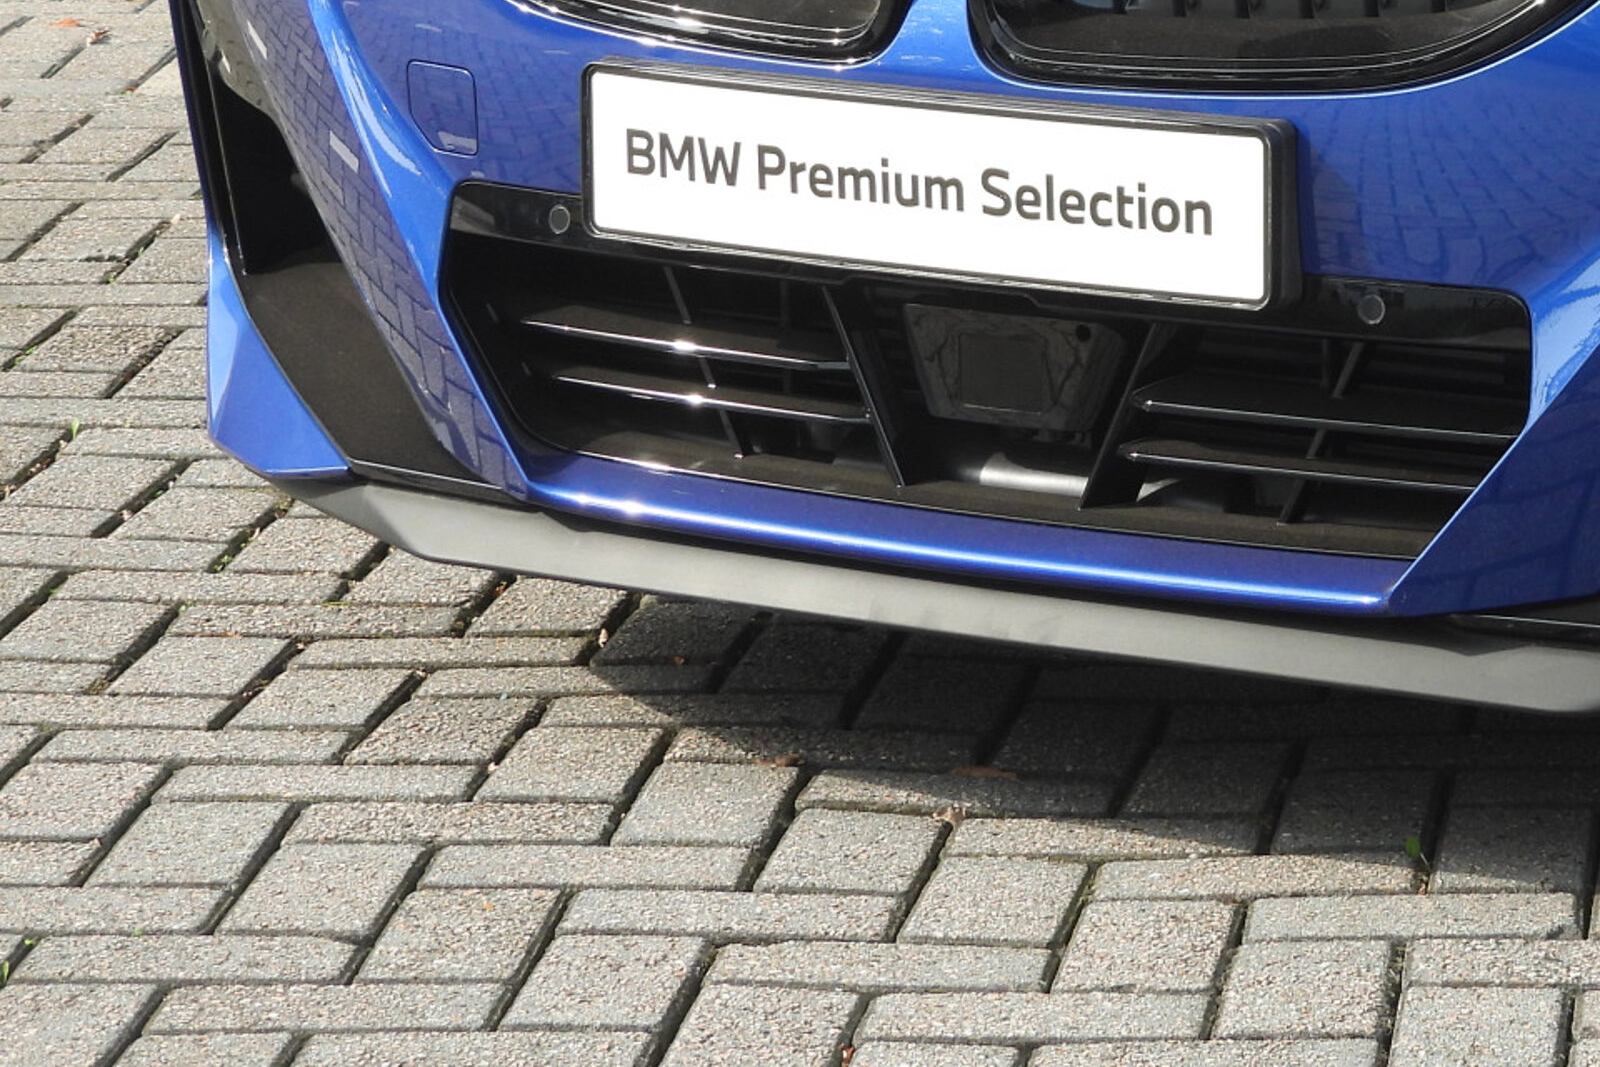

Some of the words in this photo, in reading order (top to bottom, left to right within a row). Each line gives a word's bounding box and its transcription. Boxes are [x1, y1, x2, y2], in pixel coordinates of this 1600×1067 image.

[627, 129, 740, 185] BMW
[758, 145, 963, 211] Premium
[982, 169, 1211, 234] Selection
